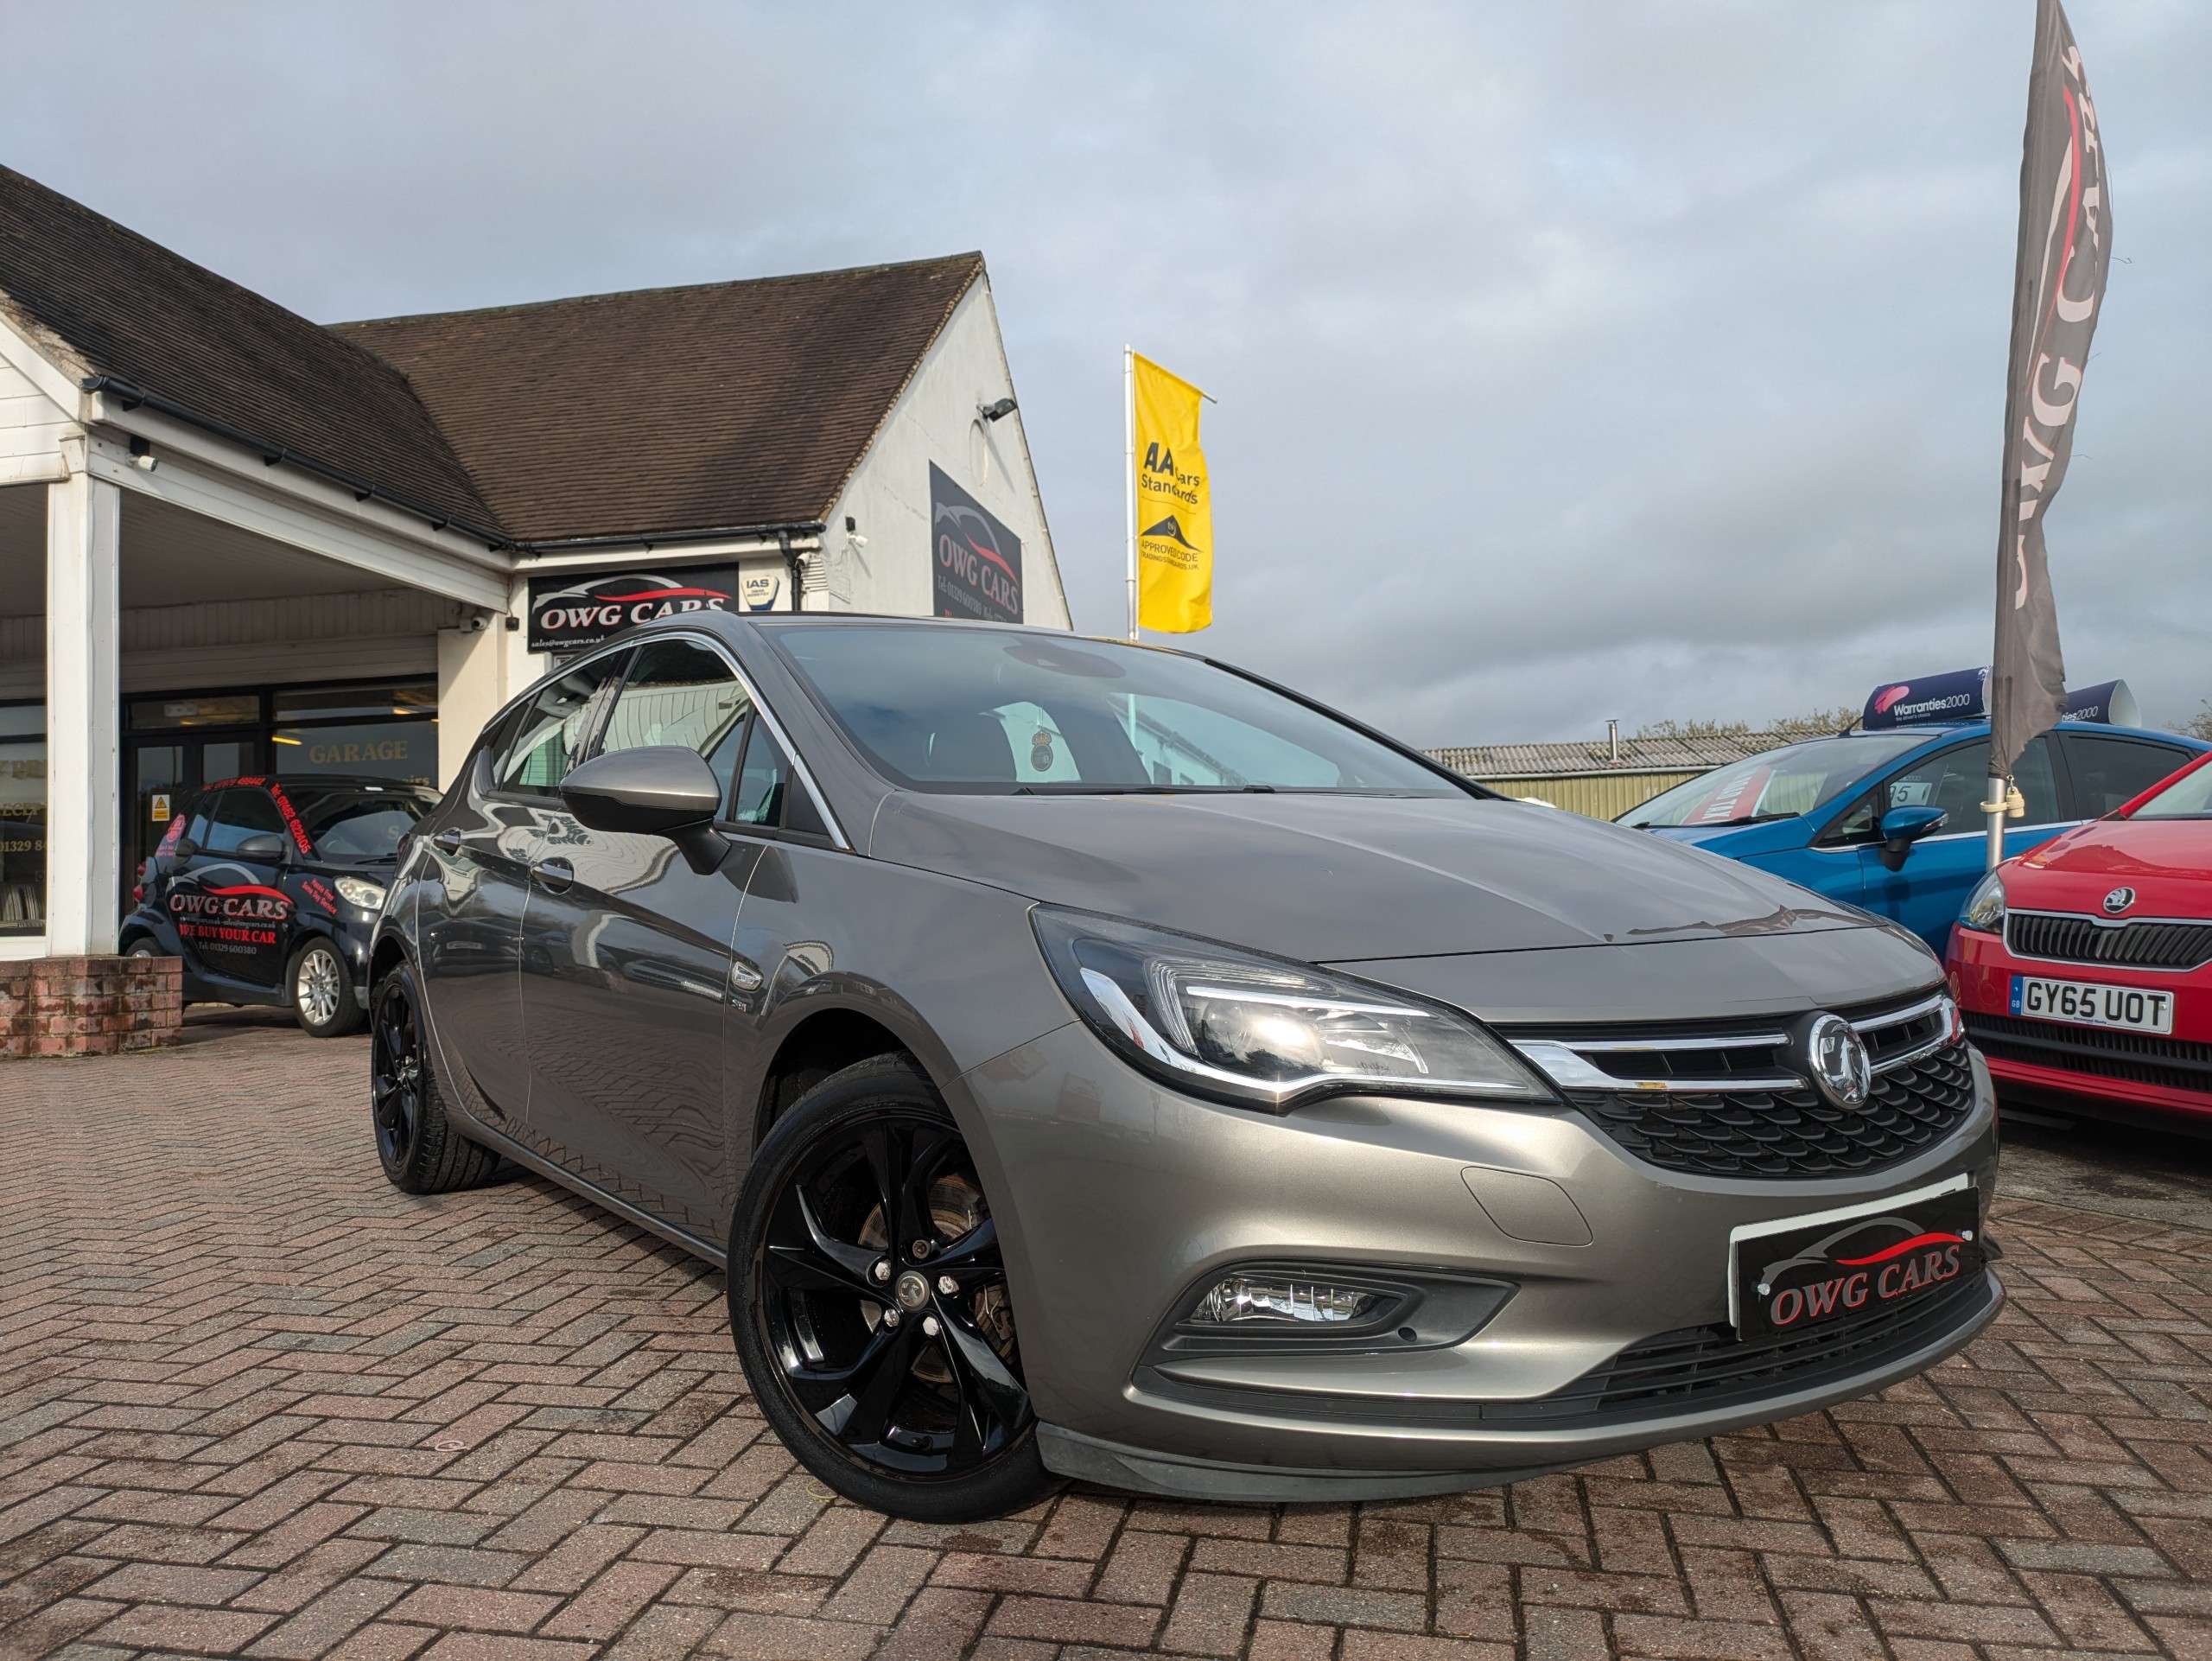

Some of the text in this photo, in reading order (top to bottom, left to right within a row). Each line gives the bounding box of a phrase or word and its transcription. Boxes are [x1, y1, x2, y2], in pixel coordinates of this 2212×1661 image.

[1144, 442, 1174, 476] AA
[747, 578, 770, 589] IAS
[938, 533, 1019, 614] OWG CARS
[540, 605, 622, 630] OWG
[1893, 693, 1971, 716] Warranties2000
[308, 740, 409, 764] GARAGE
[169, 894, 290, 920] OWG CARS
[179, 924, 277, 944] WE BUY YOUR CAR
[2026, 982, 2167, 1026] GY65 UOT
[1770, 1244, 1961, 1326] OWG CARS
